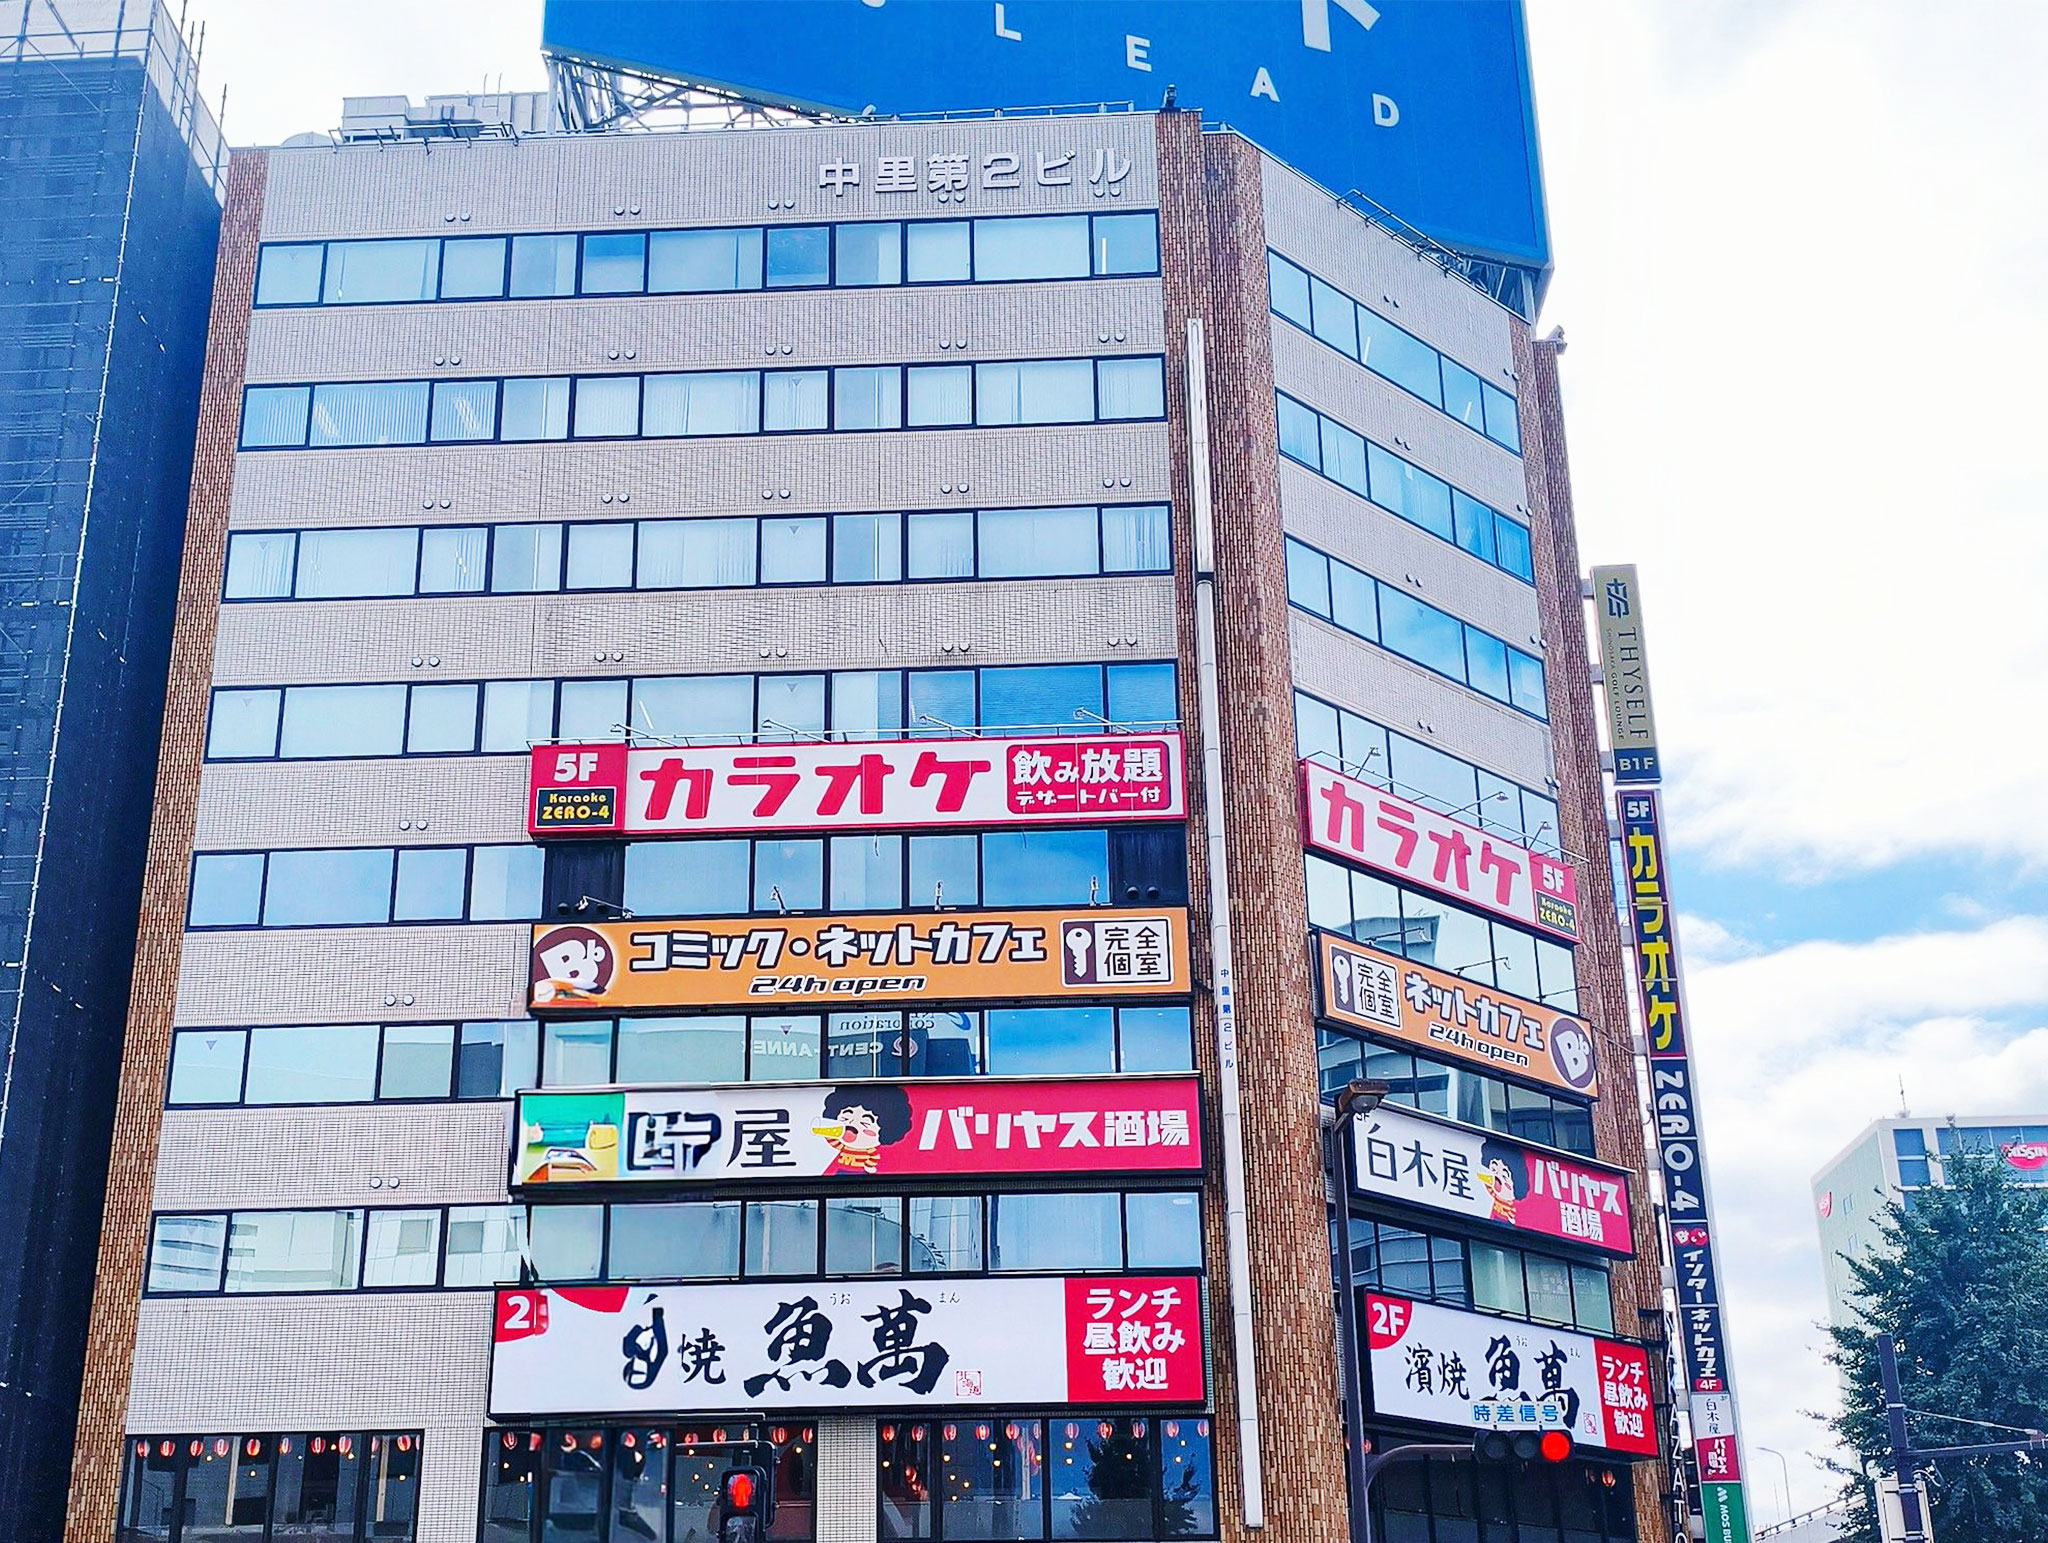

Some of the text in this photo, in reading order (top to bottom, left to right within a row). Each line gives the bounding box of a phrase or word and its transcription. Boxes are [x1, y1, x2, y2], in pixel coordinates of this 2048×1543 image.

[819, 148, 1132, 197] 中里第2ビル
[1610, 672, 1620, 696] GOLF
[1617, 626, 1649, 739] THYSELF
[1614, 700, 1625, 741] LOUNGE
[554, 752, 598, 782] 5F
[1012, 748, 1163, 785] 飲み放題
[1618, 757, 1654, 772] B1F
[549, 792, 607, 803] Karaoke
[640, 752, 991, 820] カラオケ
[1015, 786, 1161, 806] デザートバー付
[541, 805, 610, 820] ZERO-4
[1627, 800, 1650, 818] 5F
[1320, 780, 1521, 907] カラオケ
[1542, 863, 1565, 894] 5F
[1539, 908, 1576, 931] ZERO-4
[630, 922, 1047, 971] コミック・ネットカフェ
[1104, 926, 1160, 950] 完全
[1628, 827, 1677, 1050] カラオケ
[1104, 952, 1161, 977] 個室
[1358, 962, 1393, 993] 完全
[749, 974, 926, 996] 24h open
[1359, 987, 1395, 1020] 個室
[1404, 970, 1545, 1052] ネットカフェ
[1477, 1041, 1530, 1067] open
[918, 1106, 1190, 1150] バリヤス酒場
[1654, 1070, 1700, 1211] ZERO-4
[1366, 1123, 1475, 1200] 白木屋
[1534, 1158, 1623, 1216] バリヤス
[1559, 1201, 1604, 1242] 酒場
[1086, 1286, 1182, 1320] ランチ
[1371, 1301, 1405, 1336] 2F
[1082, 1320, 1186, 1355] 昼飲み
[1101, 1357, 1169, 1391] 歓迎
[1602, 1355, 1645, 1385] ランチ
[1700, 1380, 1717, 1390] 4F
[1603, 1380, 1649, 1412] 昼飲み
[1473, 1404, 1559, 1423] 時差信号
[1613, 1409, 1646, 1438] 歓迎
[1719, 1504, 1733, 1543] MOS BU
